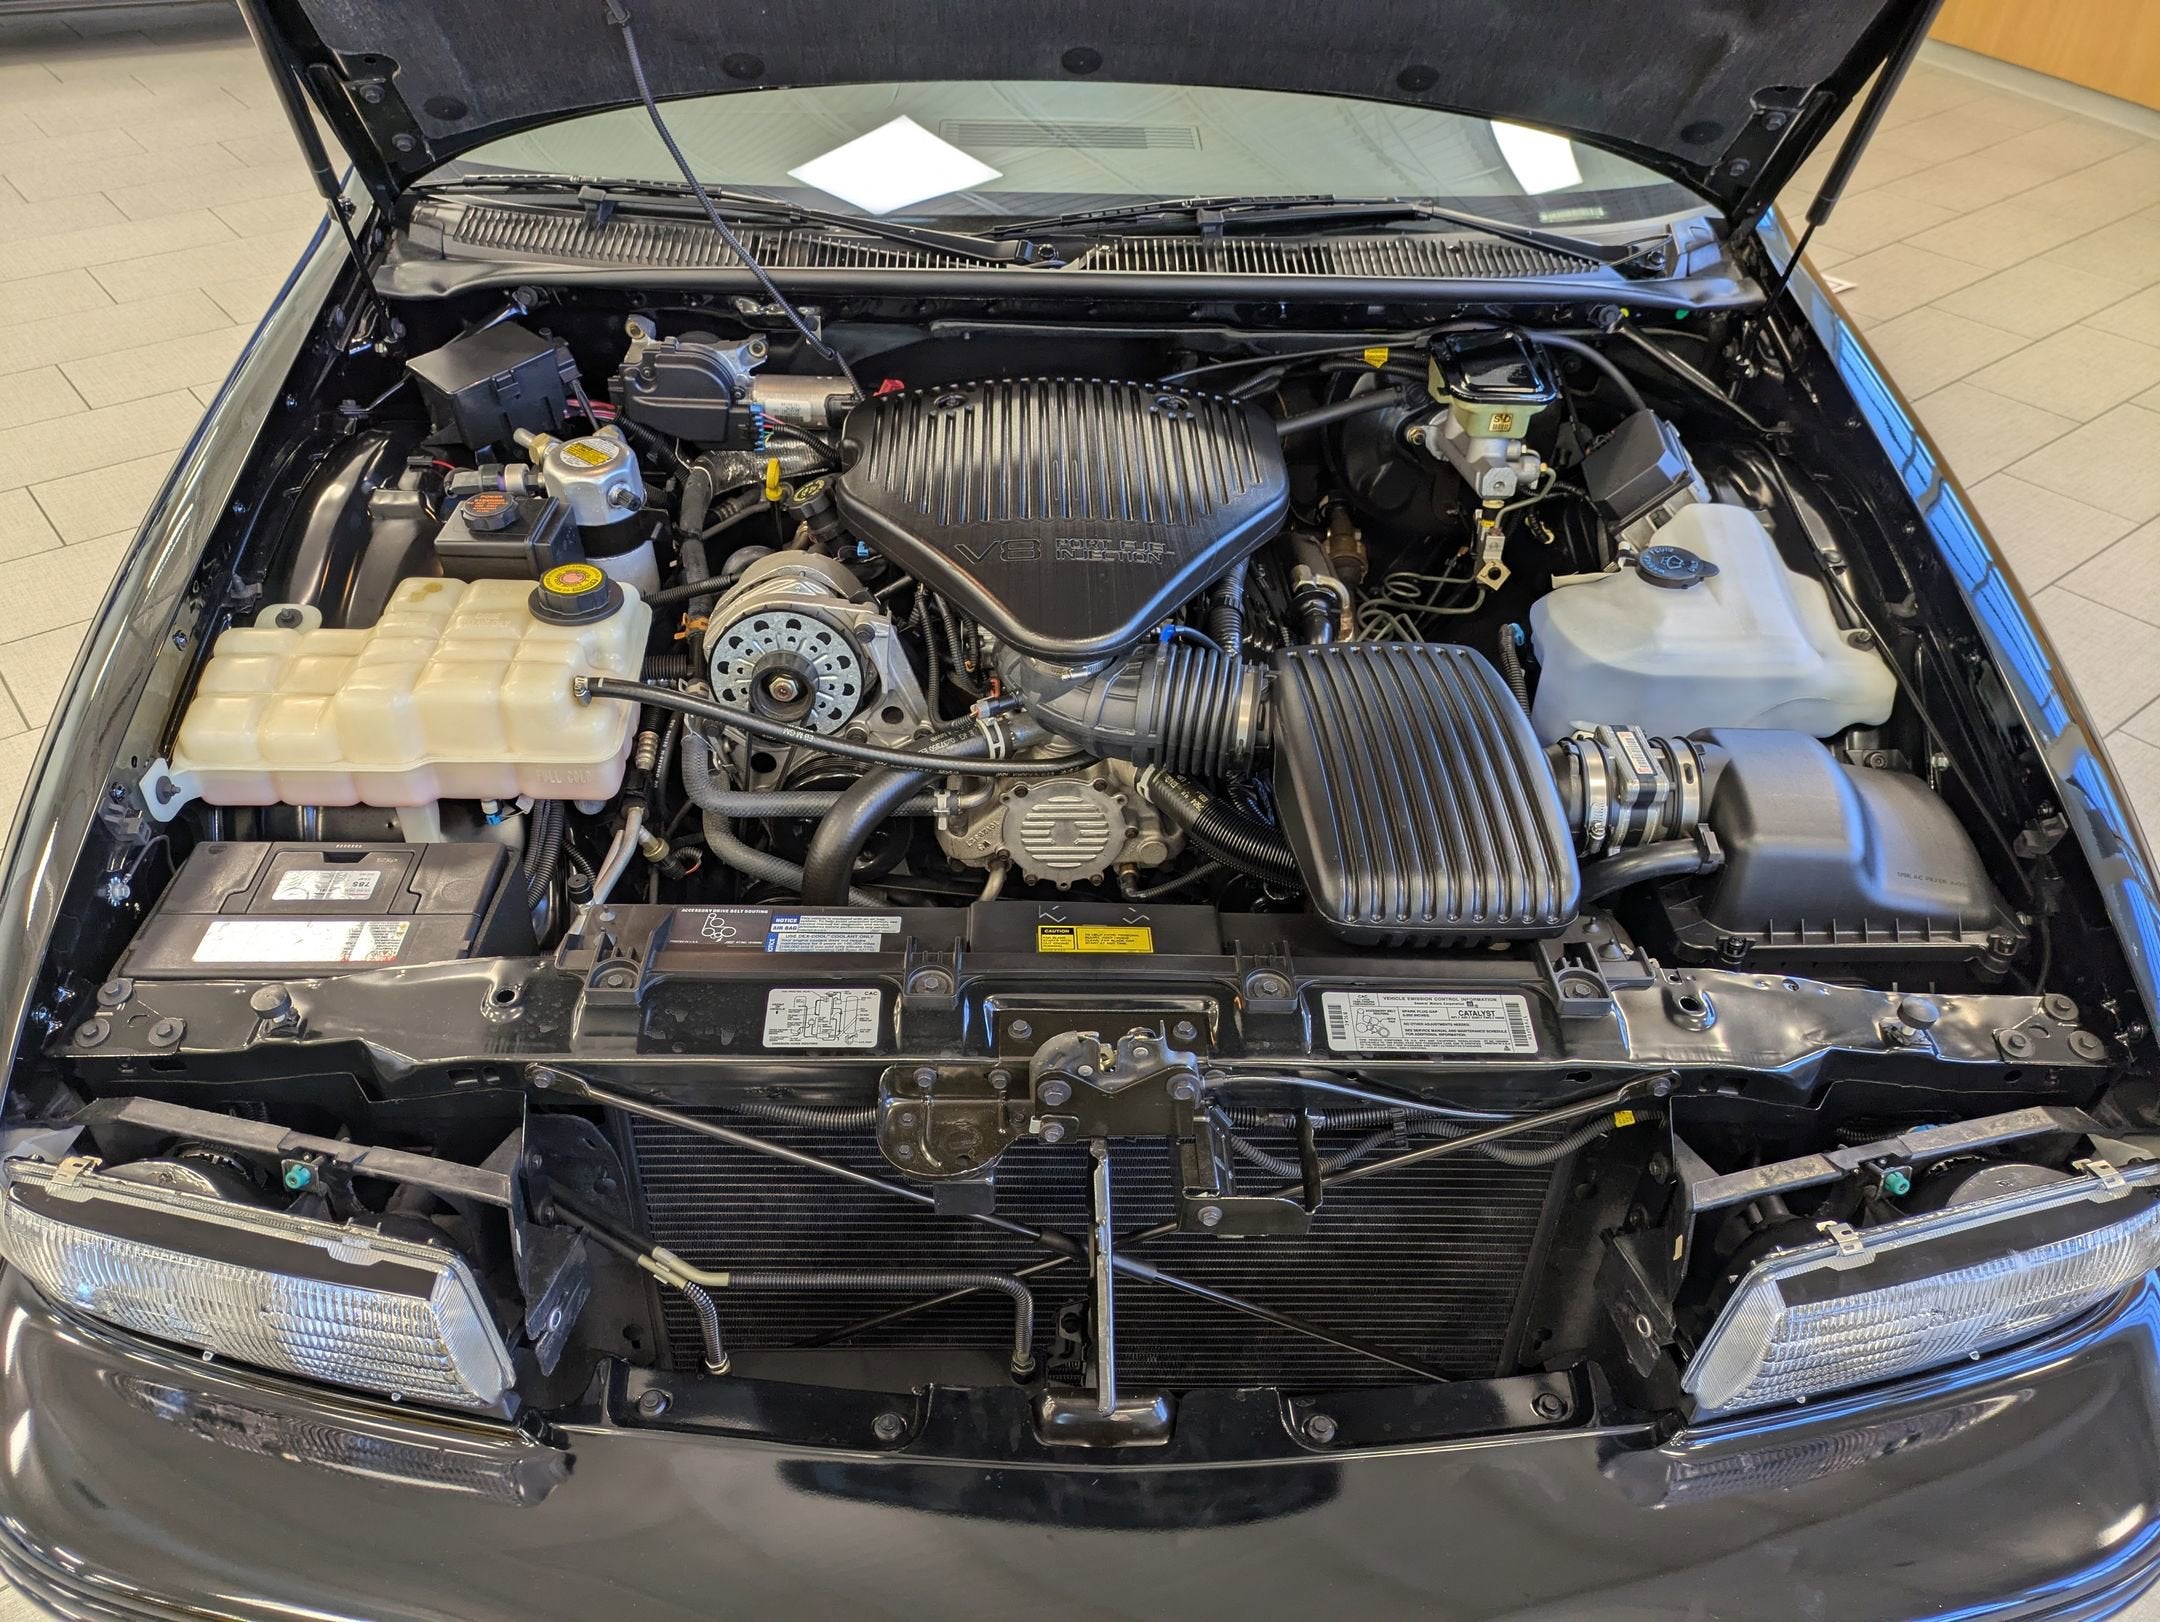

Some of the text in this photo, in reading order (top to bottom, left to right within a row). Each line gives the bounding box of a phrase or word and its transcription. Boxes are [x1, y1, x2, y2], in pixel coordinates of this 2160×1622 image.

[954, 538, 1042, 565] V8
[1055, 538, 1113, 549] PORT
[1056, 549, 1164, 565] INJECTION
[537, 768, 592, 784] FULL COLD
